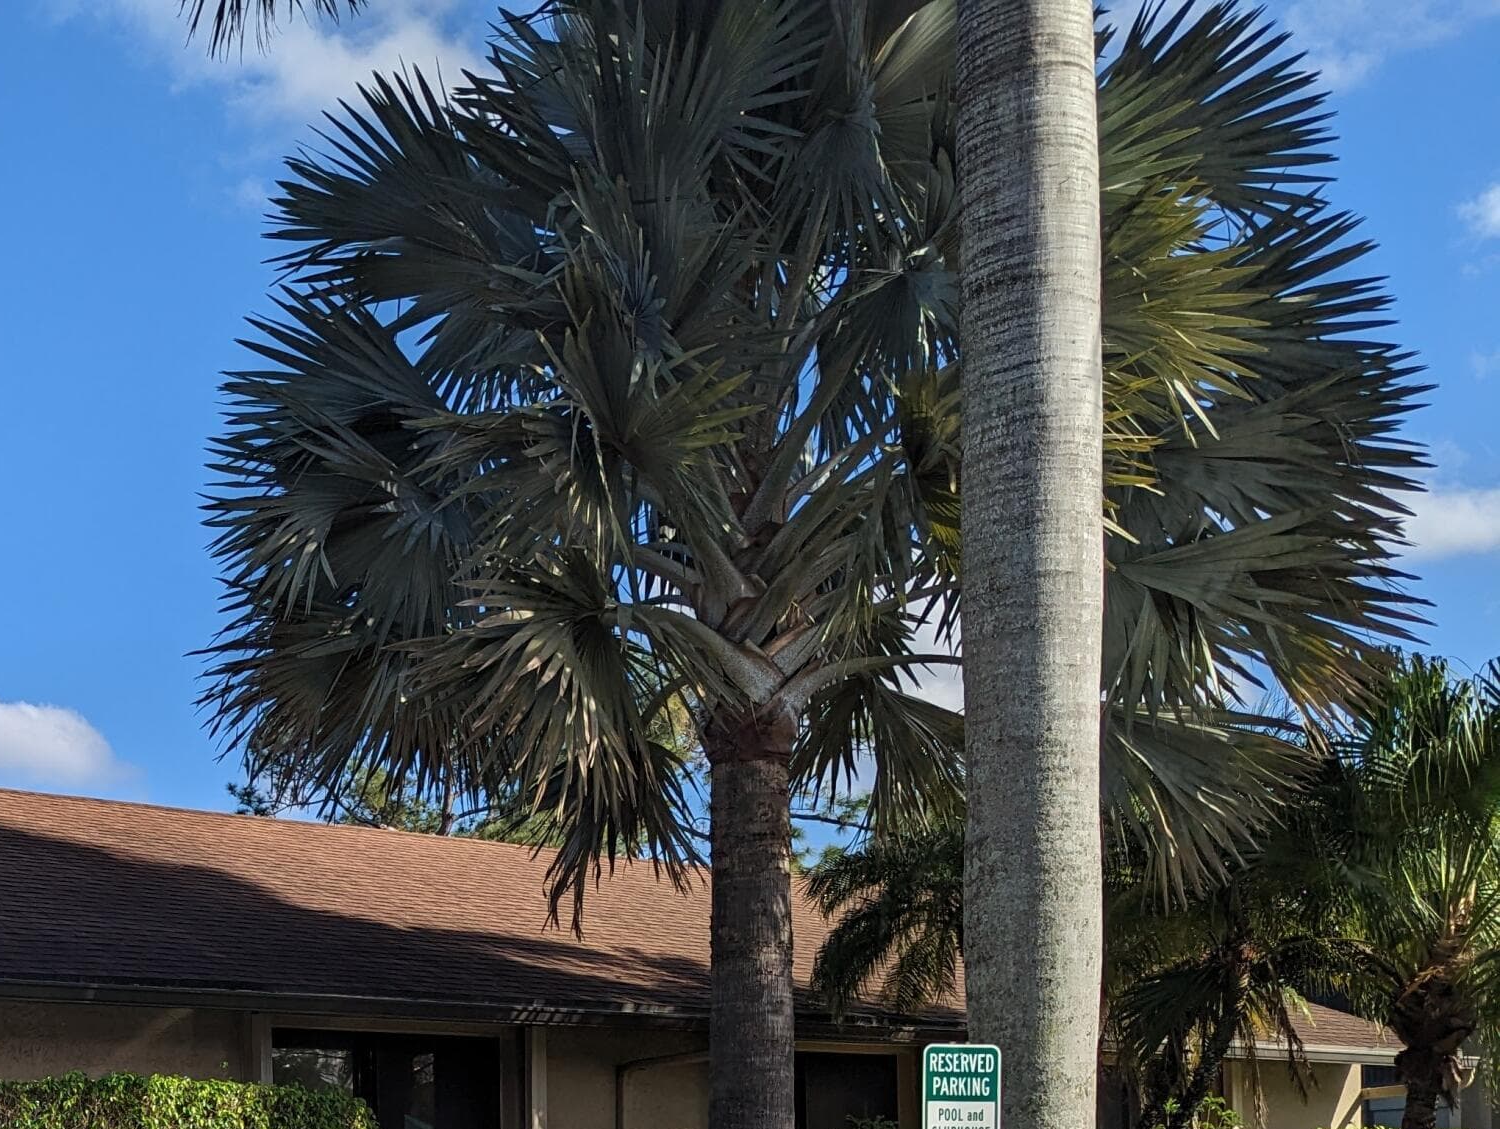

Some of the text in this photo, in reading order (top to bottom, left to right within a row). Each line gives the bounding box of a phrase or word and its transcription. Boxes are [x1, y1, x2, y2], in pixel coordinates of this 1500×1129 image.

[929, 1053, 994, 1073] RESERVED
[932, 1077, 990, 1097] PARKING
[938, 1108, 984, 1122] POOL and
